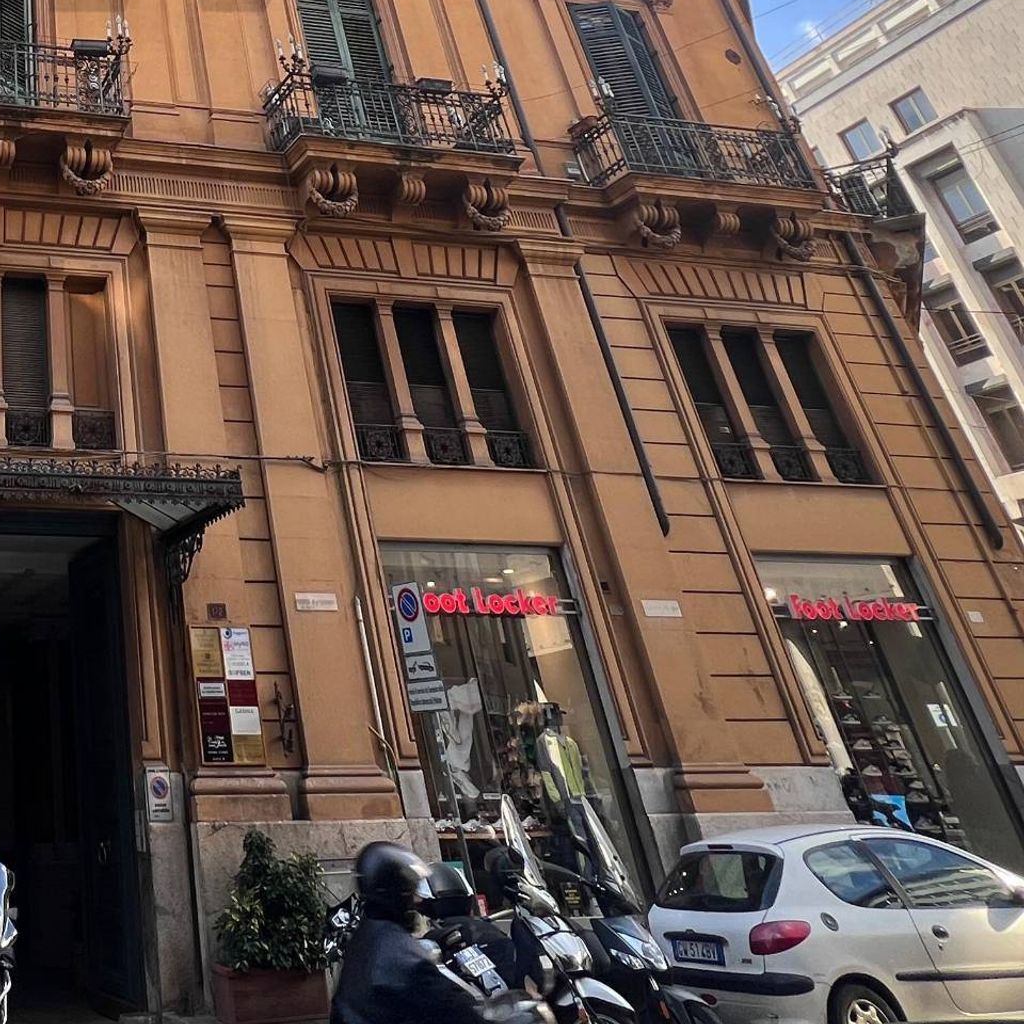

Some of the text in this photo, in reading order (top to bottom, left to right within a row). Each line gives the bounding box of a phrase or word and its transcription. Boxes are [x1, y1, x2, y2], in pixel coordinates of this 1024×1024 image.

[422, 587, 559, 615] oot Locker
[789, 593, 920, 621] Foot Locker
